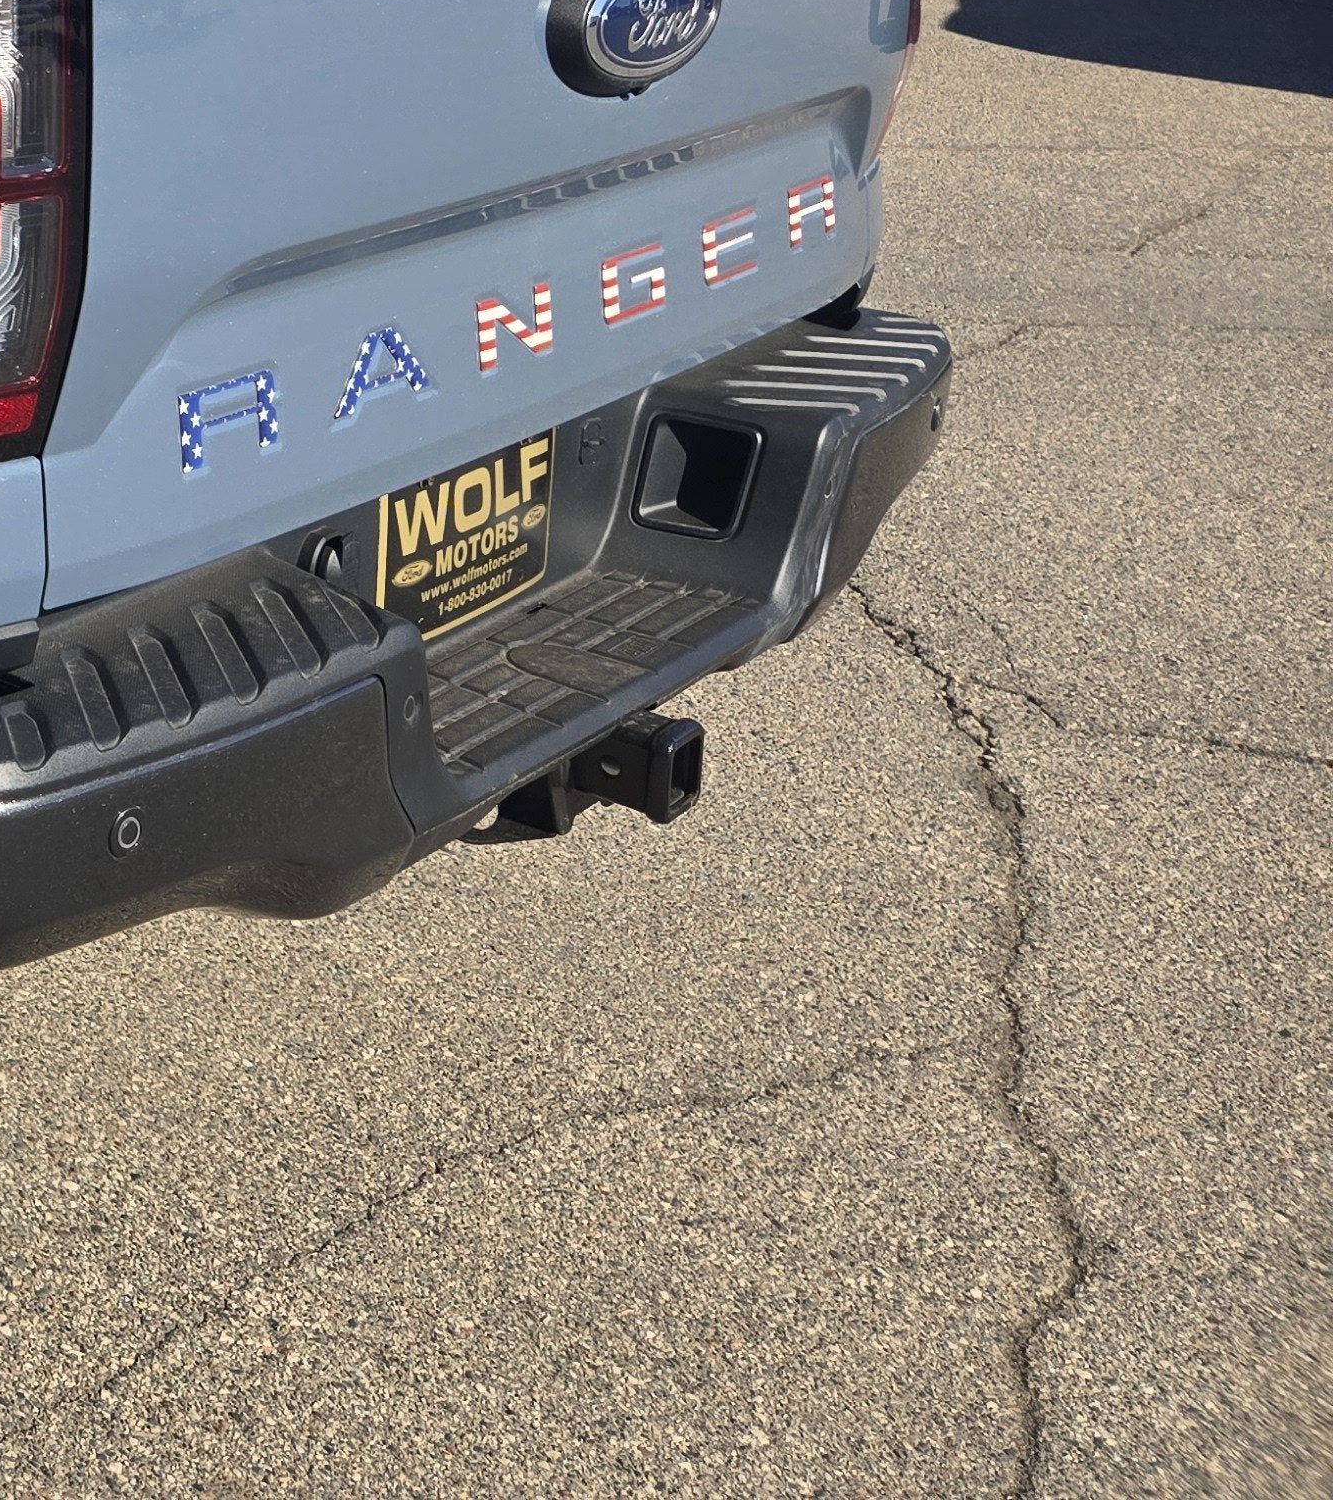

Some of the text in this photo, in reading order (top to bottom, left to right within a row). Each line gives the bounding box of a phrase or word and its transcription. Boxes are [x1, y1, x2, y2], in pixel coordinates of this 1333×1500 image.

[178, 175, 835, 474] RANGER
[395, 438, 548, 556] WOLF
[420, 543, 528, 602] www.wolfmotors.com
[435, 515, 518, 577] MOTORS
[438, 569, 513, 616] 1-800-830-0017
